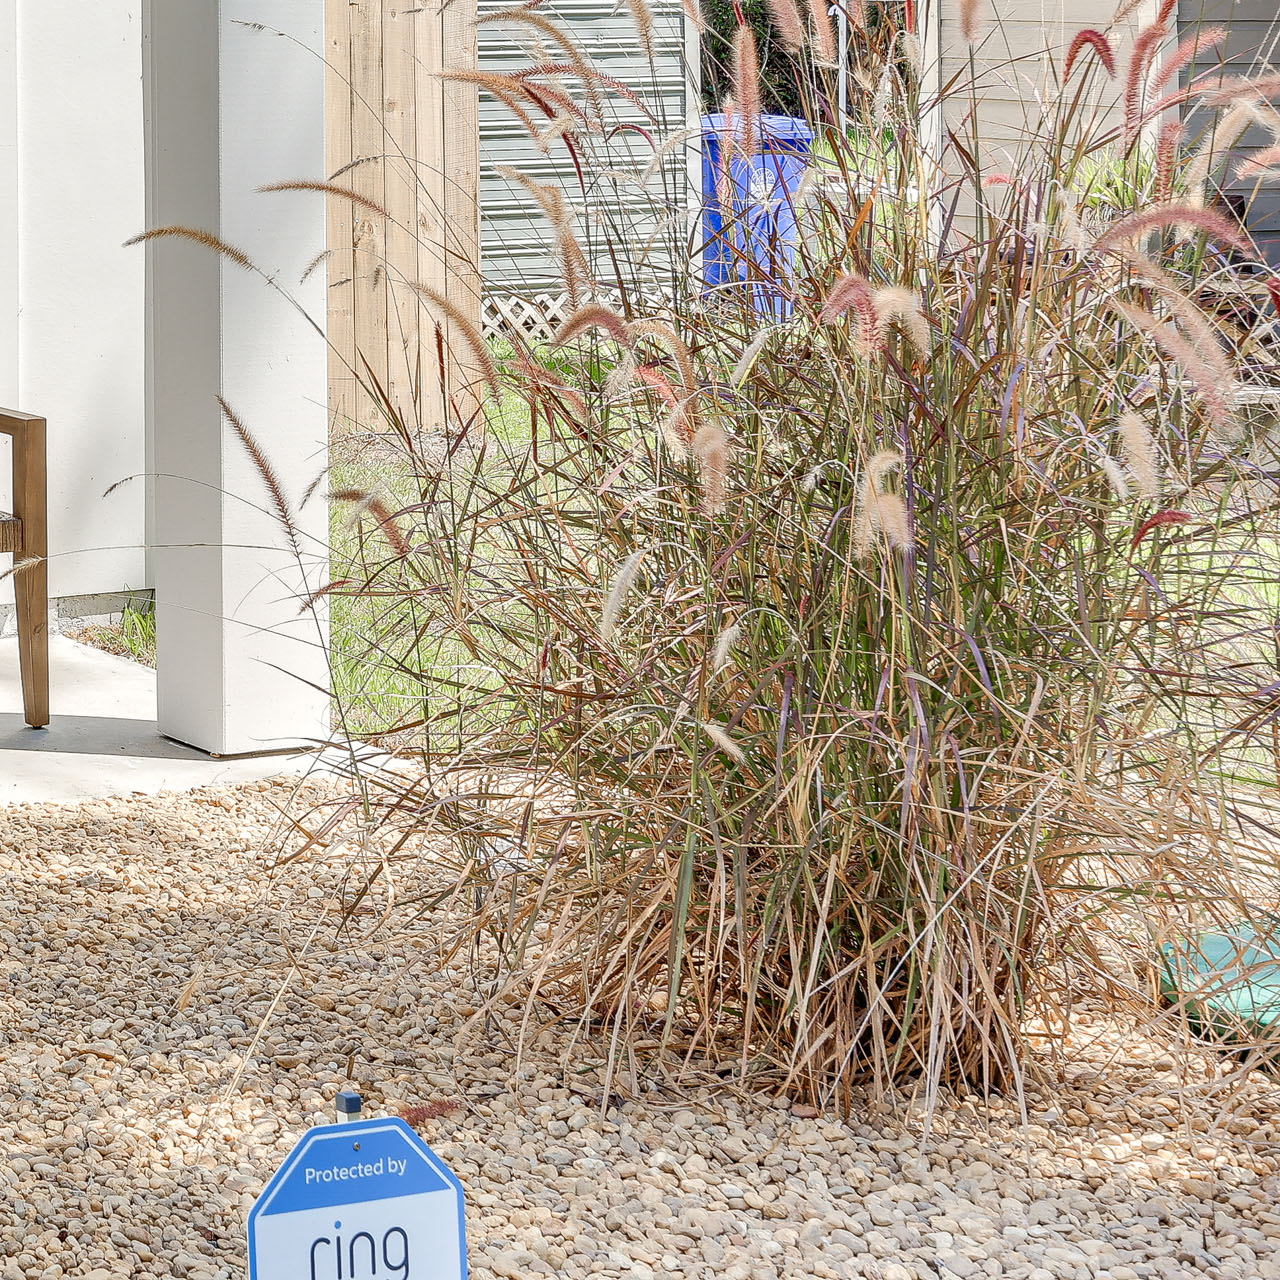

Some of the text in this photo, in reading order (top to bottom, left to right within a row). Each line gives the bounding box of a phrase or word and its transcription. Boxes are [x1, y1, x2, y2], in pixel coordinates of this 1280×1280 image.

[305, 1156, 407, 1184] Protected by
[310, 1220, 409, 1280] ring
